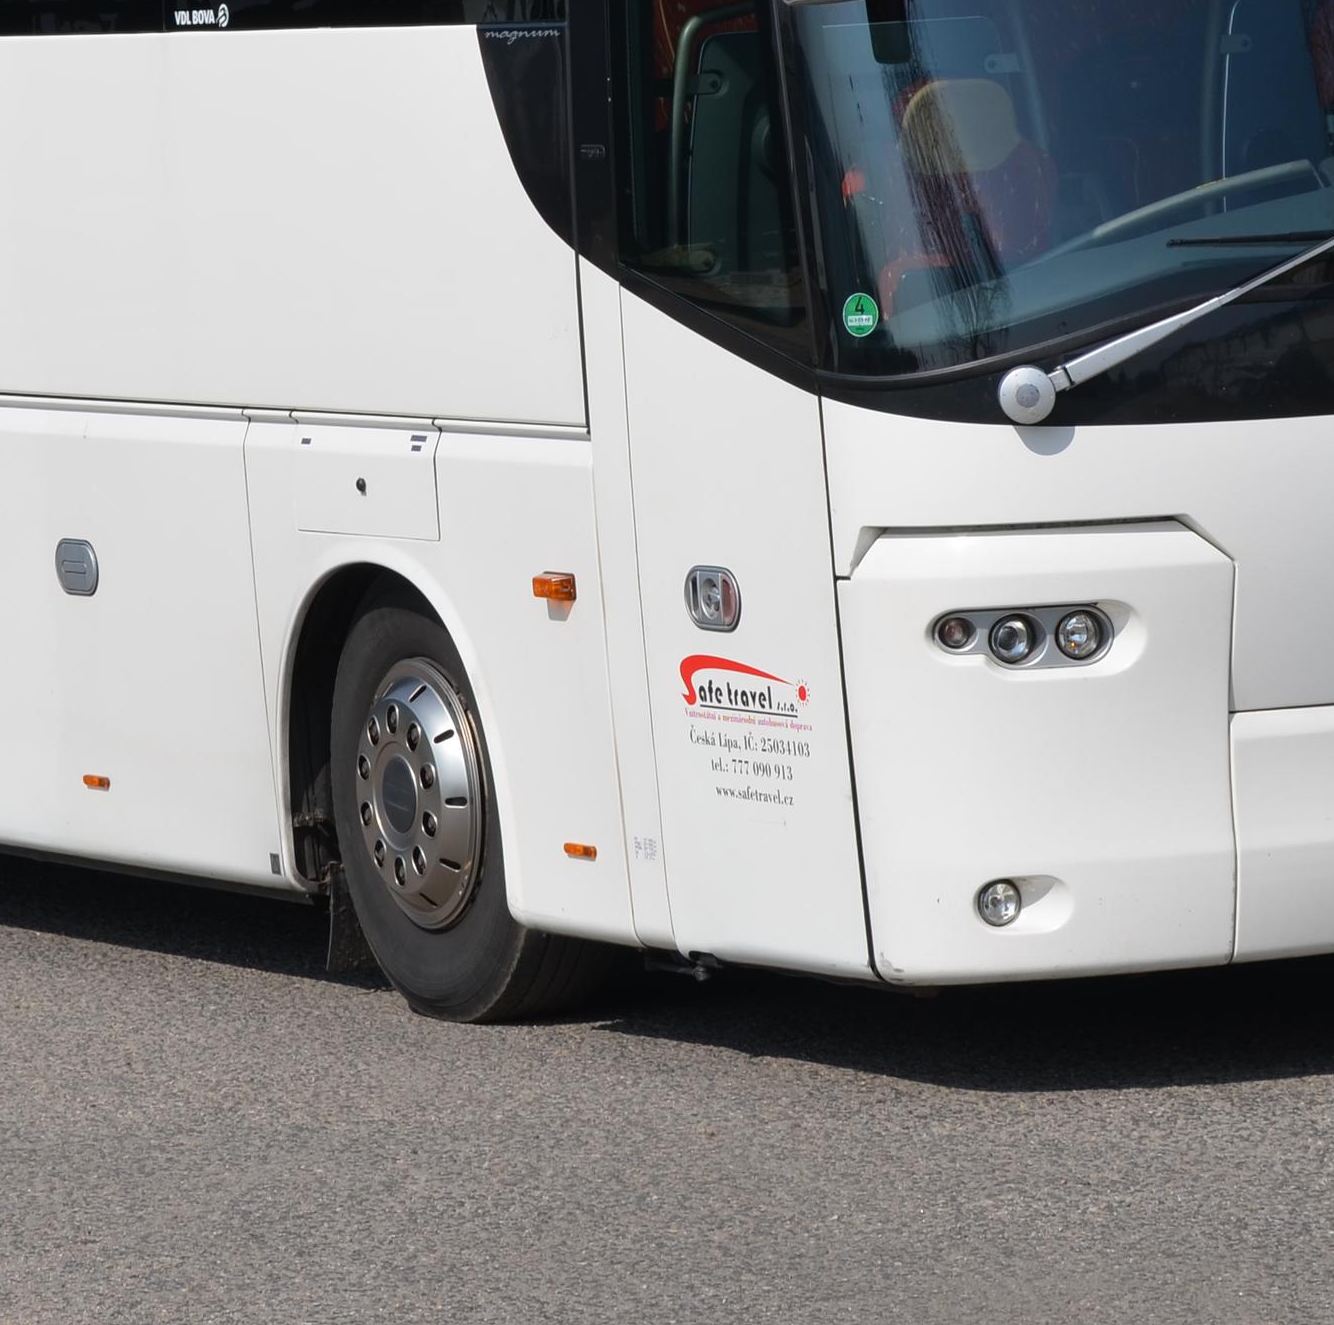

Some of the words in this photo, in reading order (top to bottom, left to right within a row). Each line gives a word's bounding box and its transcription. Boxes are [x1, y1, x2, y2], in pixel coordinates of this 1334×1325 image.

[174, 10, 191, 25] VDL
[192, 9, 215, 25] BOVA
[485, 28, 560, 45] magnum
[855, 296, 865, 315] 4
[727, 682, 772, 710] travel
[689, 725, 716, 746] Česká
[718, 732, 741, 753] Lípa,
[743, 732, 758, 752] IČ:
[760, 738, 811, 758] 25034103
[711, 757, 729, 773] tel.:
[731, 759, 750, 776] 777
[752, 761, 772, 778] 090
[775, 764, 793, 780] 913
[716, 785, 794, 806] www.safetravel.cz
